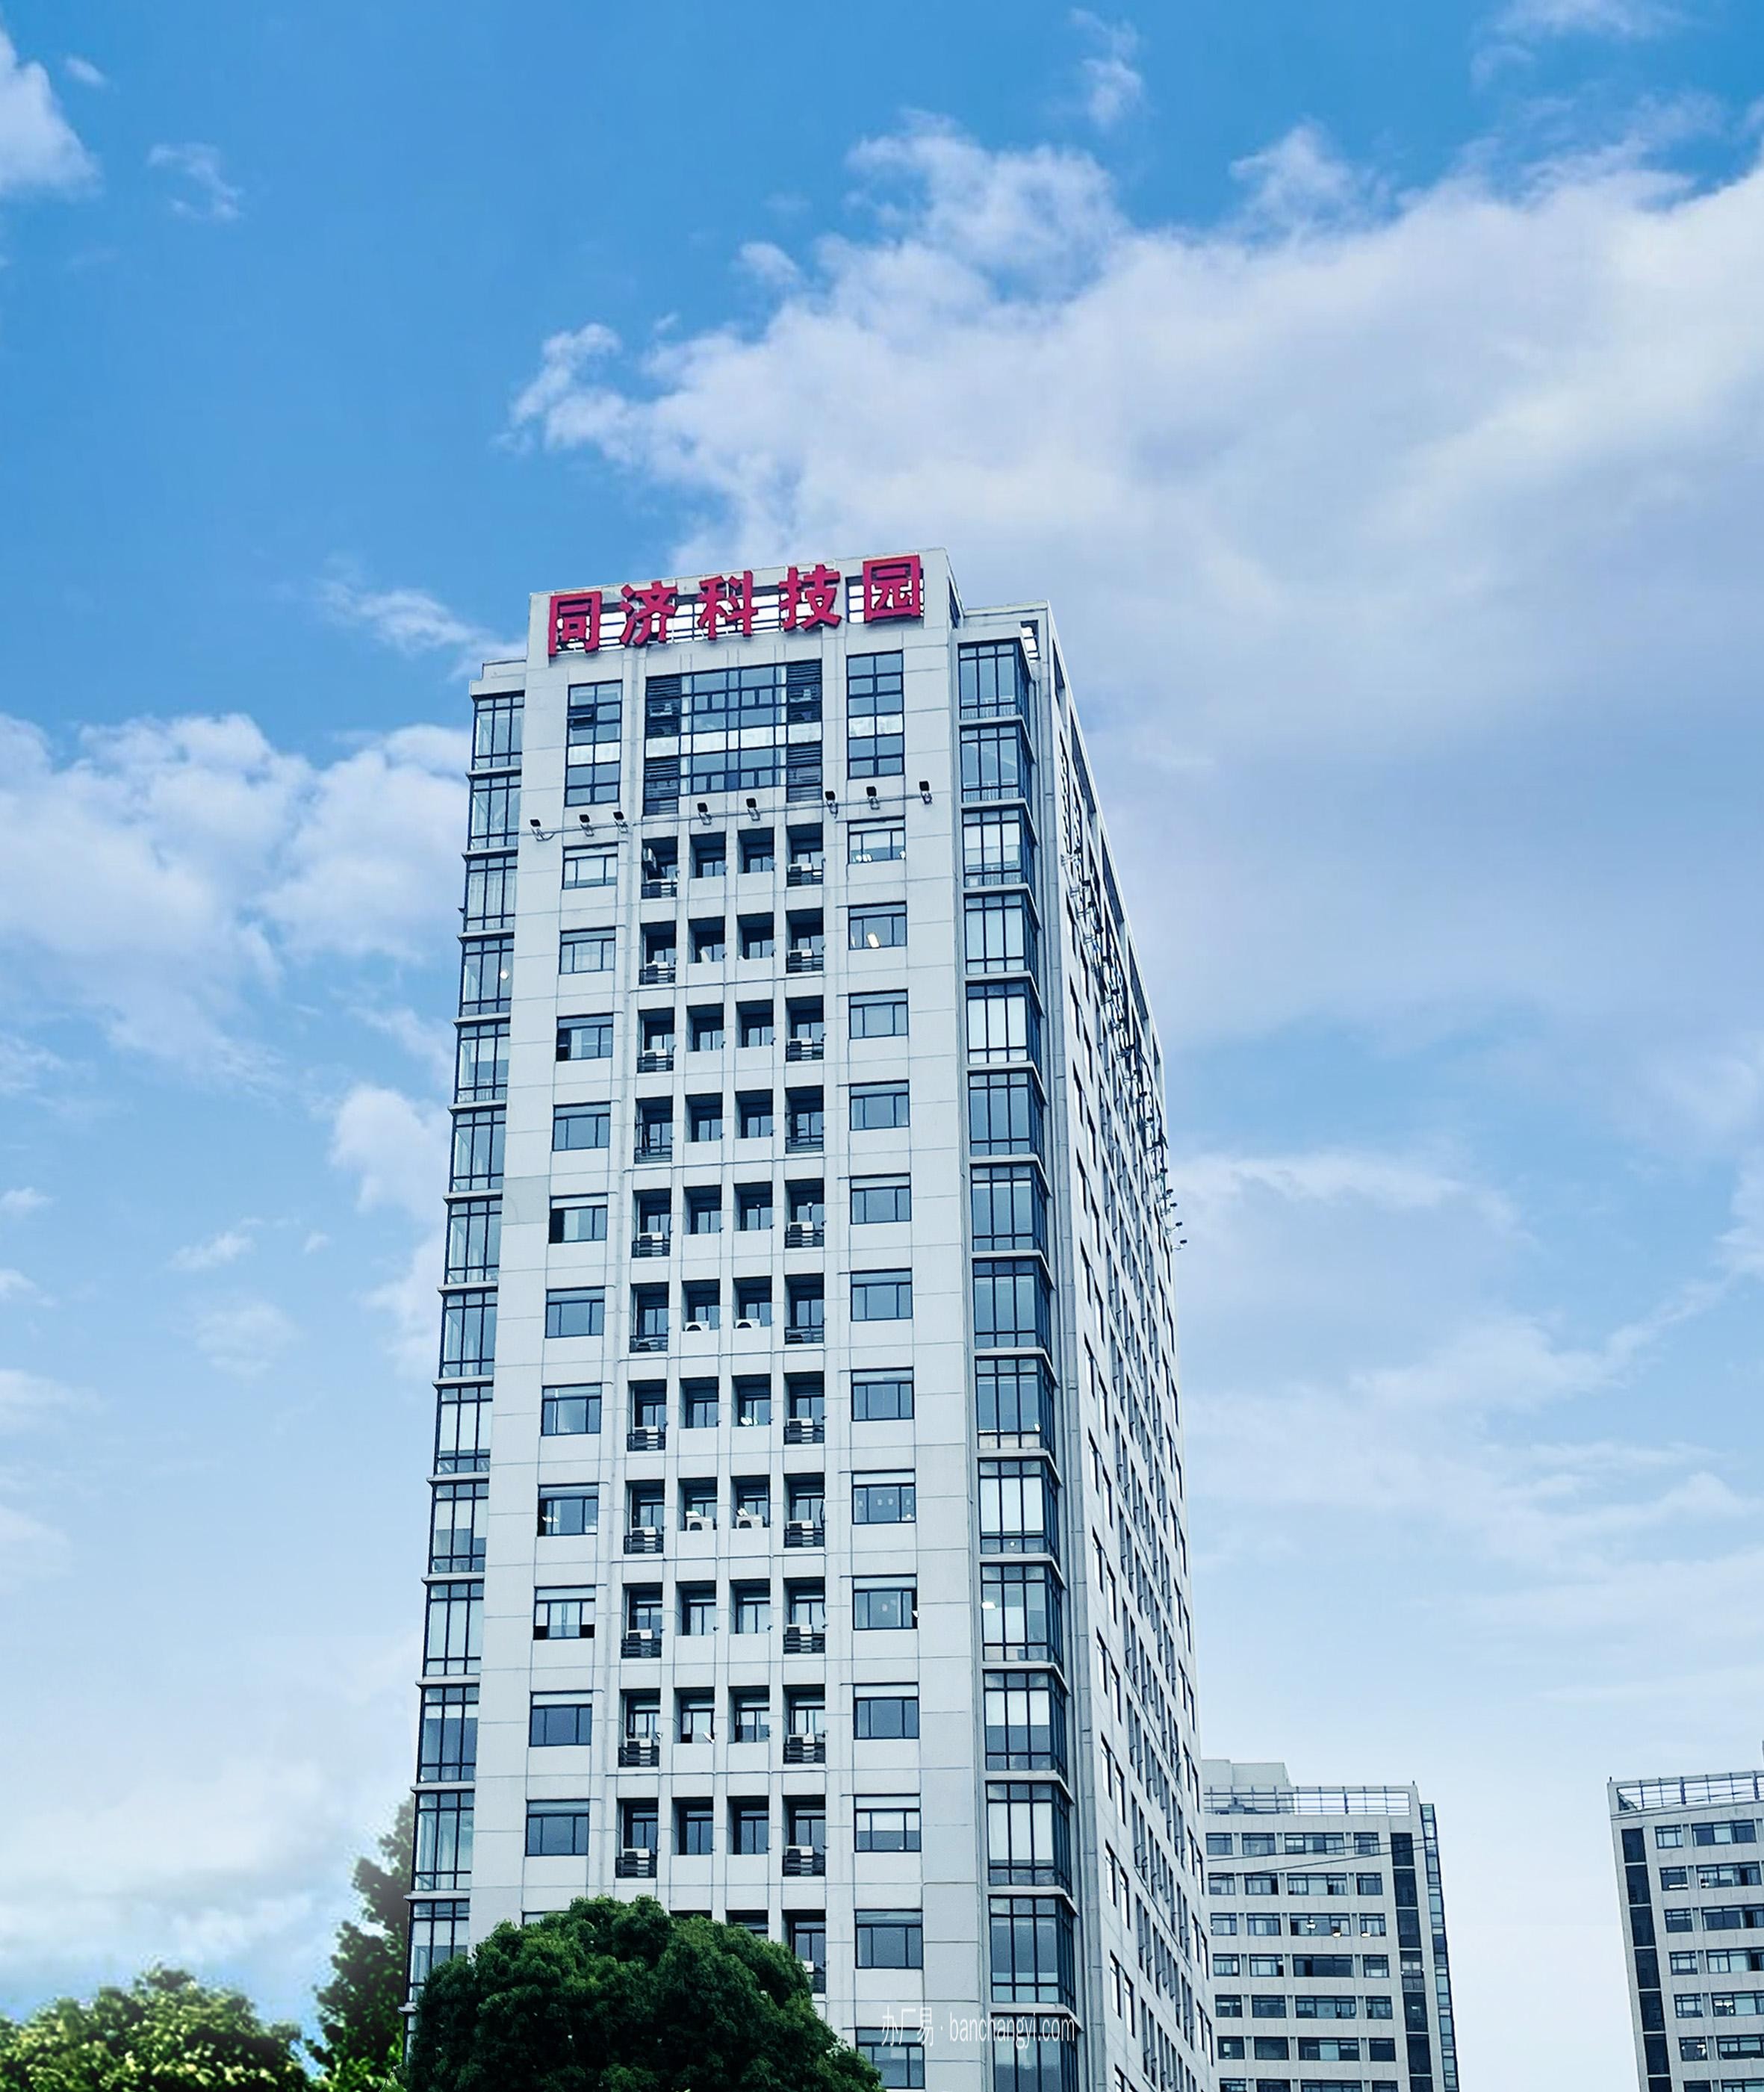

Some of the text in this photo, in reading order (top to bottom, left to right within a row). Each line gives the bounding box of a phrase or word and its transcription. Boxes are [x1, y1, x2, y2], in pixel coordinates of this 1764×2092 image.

[548, 555, 922, 656] 同济科技园
